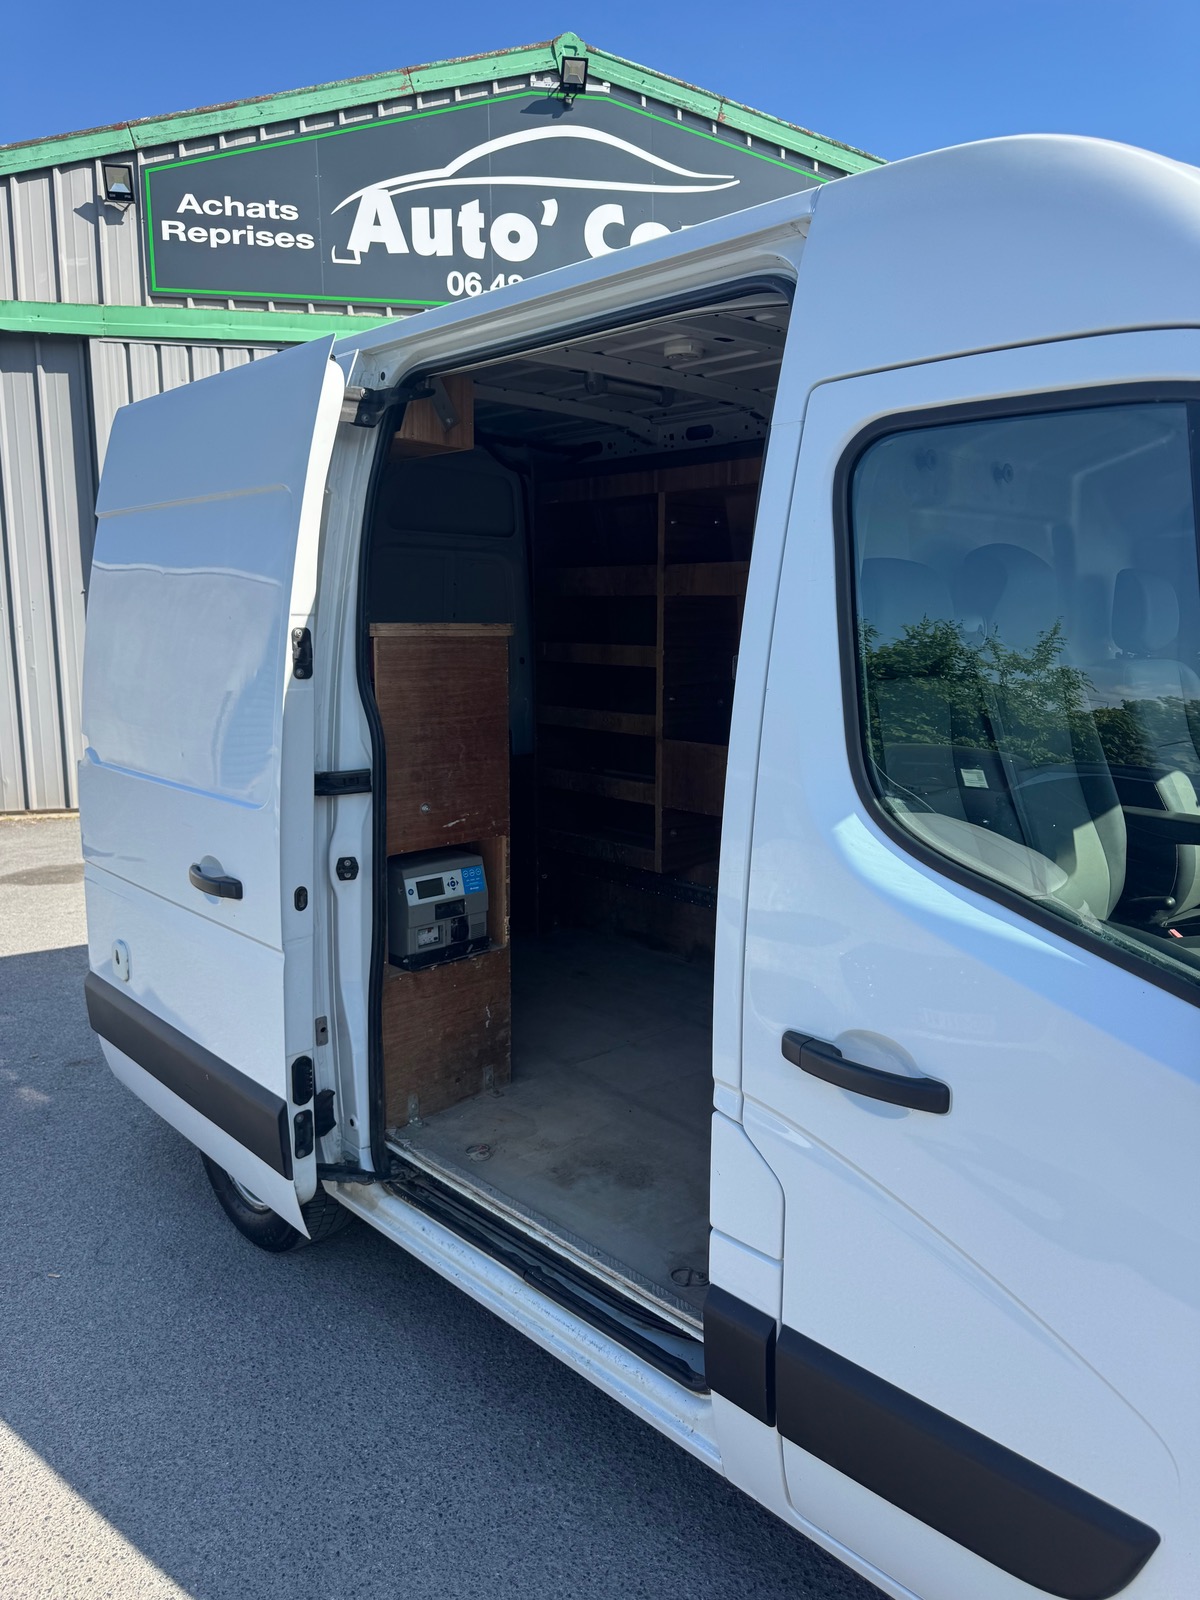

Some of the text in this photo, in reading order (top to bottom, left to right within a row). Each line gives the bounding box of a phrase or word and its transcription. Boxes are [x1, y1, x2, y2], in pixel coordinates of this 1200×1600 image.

[177, 193, 299, 221] Achats
[161, 220, 315, 249] Reprises
[346, 189, 559, 262] Auto'
